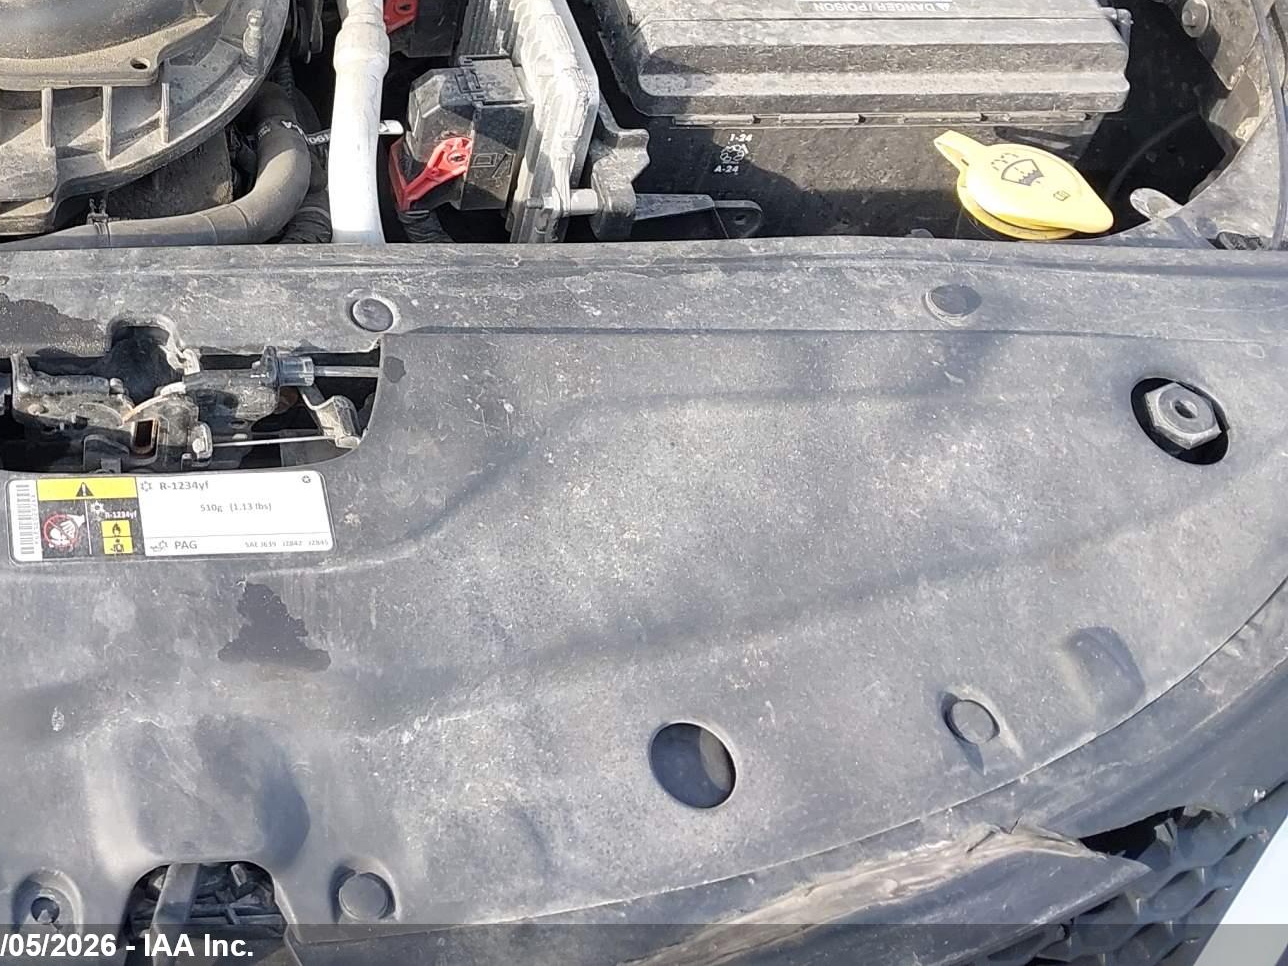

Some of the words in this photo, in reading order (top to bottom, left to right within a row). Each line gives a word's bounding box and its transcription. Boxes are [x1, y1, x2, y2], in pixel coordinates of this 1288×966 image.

[876, 2, 936, 12] DANGER
[729, 133, 753, 142] 1-24
[713, 164, 739, 173] A-24
[159, 479, 210, 491] R-1234yf
[200, 502, 223, 513] 510g
[229, 501, 253, 512] (1.13
[255, 500, 273, 512] lbs)
[174, 540, 198, 551] PAG
